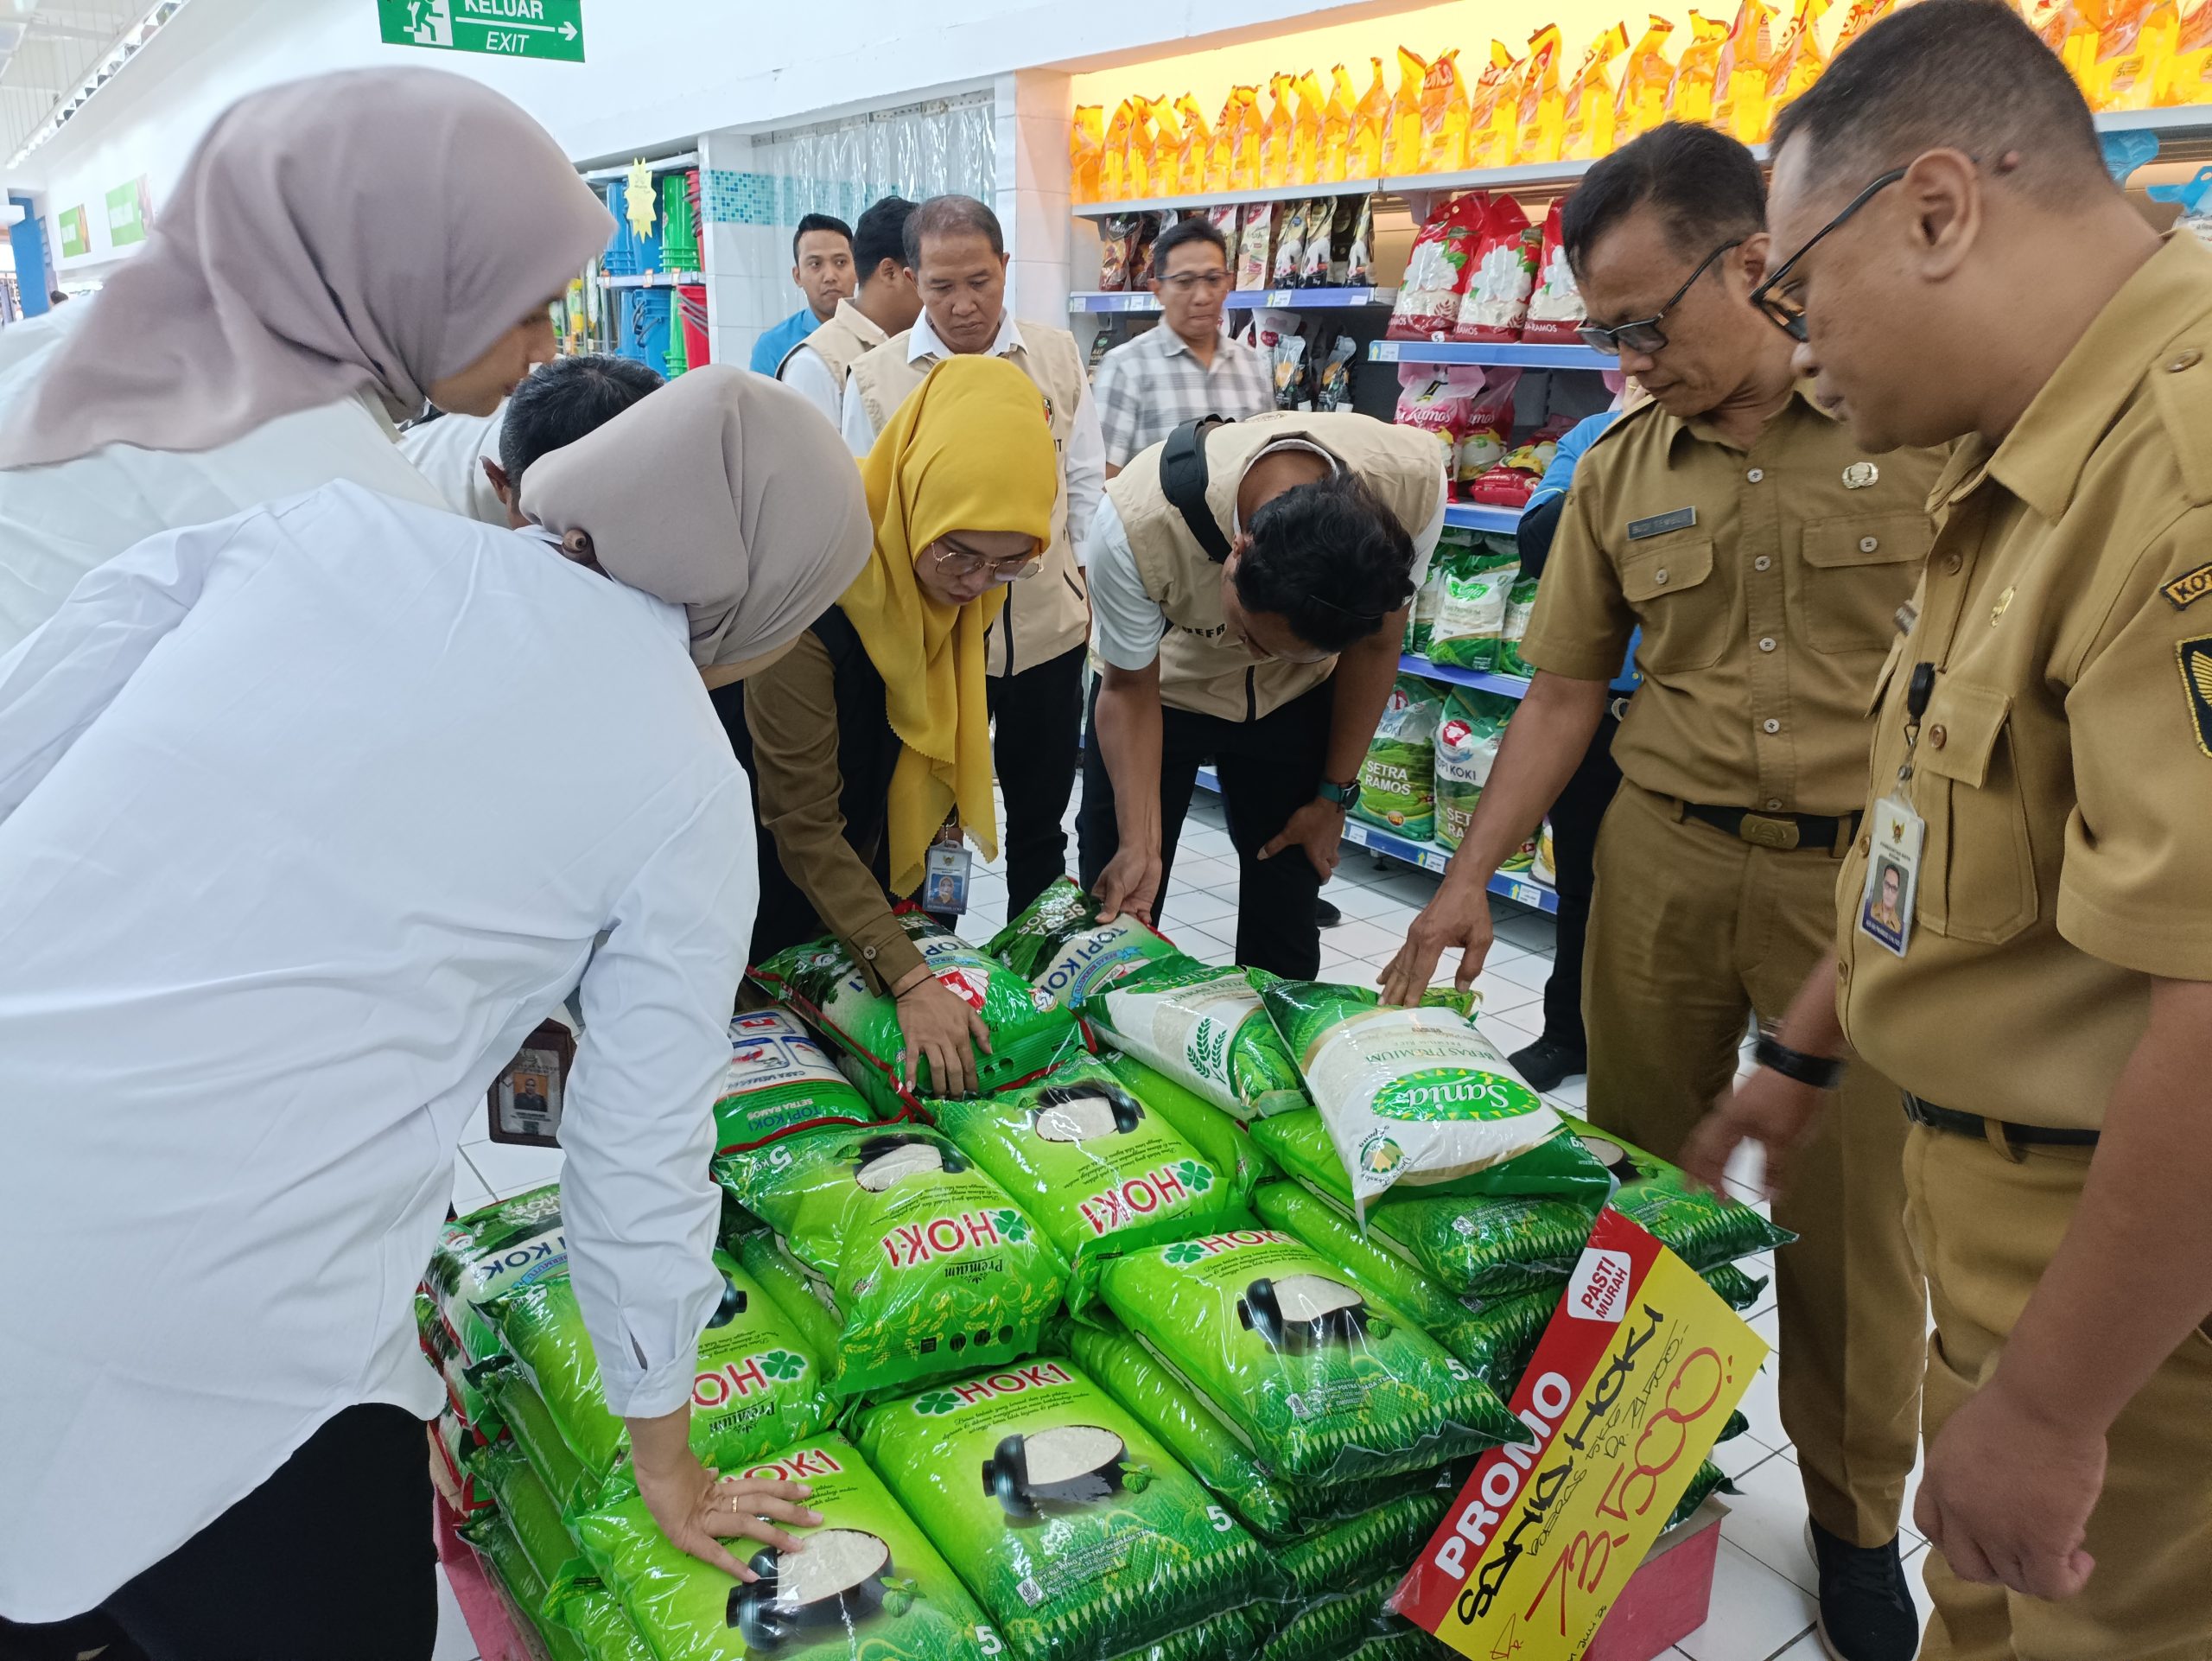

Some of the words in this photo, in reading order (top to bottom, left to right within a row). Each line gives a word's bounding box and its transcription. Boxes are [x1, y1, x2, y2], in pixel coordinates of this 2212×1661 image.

[465, 0, 543, 19] KELUAR
[486, 31, 530, 54] EXIT
[1367, 760, 1408, 781] SETRA
[1450, 765, 1477, 780] KOKI
[1365, 774, 1411, 796] RAMOS
[1446, 807, 1473, 826] SET
[1076, 927, 1128, 962] TOPI
[1365, 1047, 1446, 1063] PREMIUM
[1446, 1047, 1496, 1061] BERAS
[782, 1098, 813, 1111] SETRA
[1408, 1081, 1510, 1112] Sania
[746, 1105, 782, 1120] RAMOS
[747, 1112, 785, 1131] KOKI
[787, 1105, 821, 1121] TOPI
[770, 1145, 792, 1174] 5
[1079, 1167, 1186, 1234] HOK-1
[881, 1212, 999, 1267] HOK-1
[474, 1241, 552, 1286] KOK
[944, 1258, 1002, 1279] Premium
[1581, 1256, 1616, 1310] PASTI
[1596, 1267, 1628, 1319] MURAH
[1446, 1359, 1470, 1381] 5
[952, 1362, 1074, 1404] HOK-1
[1434, 1371, 1571, 1580] PROMO
[1206, 1505, 1233, 1533] 5
[974, 1625, 1002, 1656] 5
